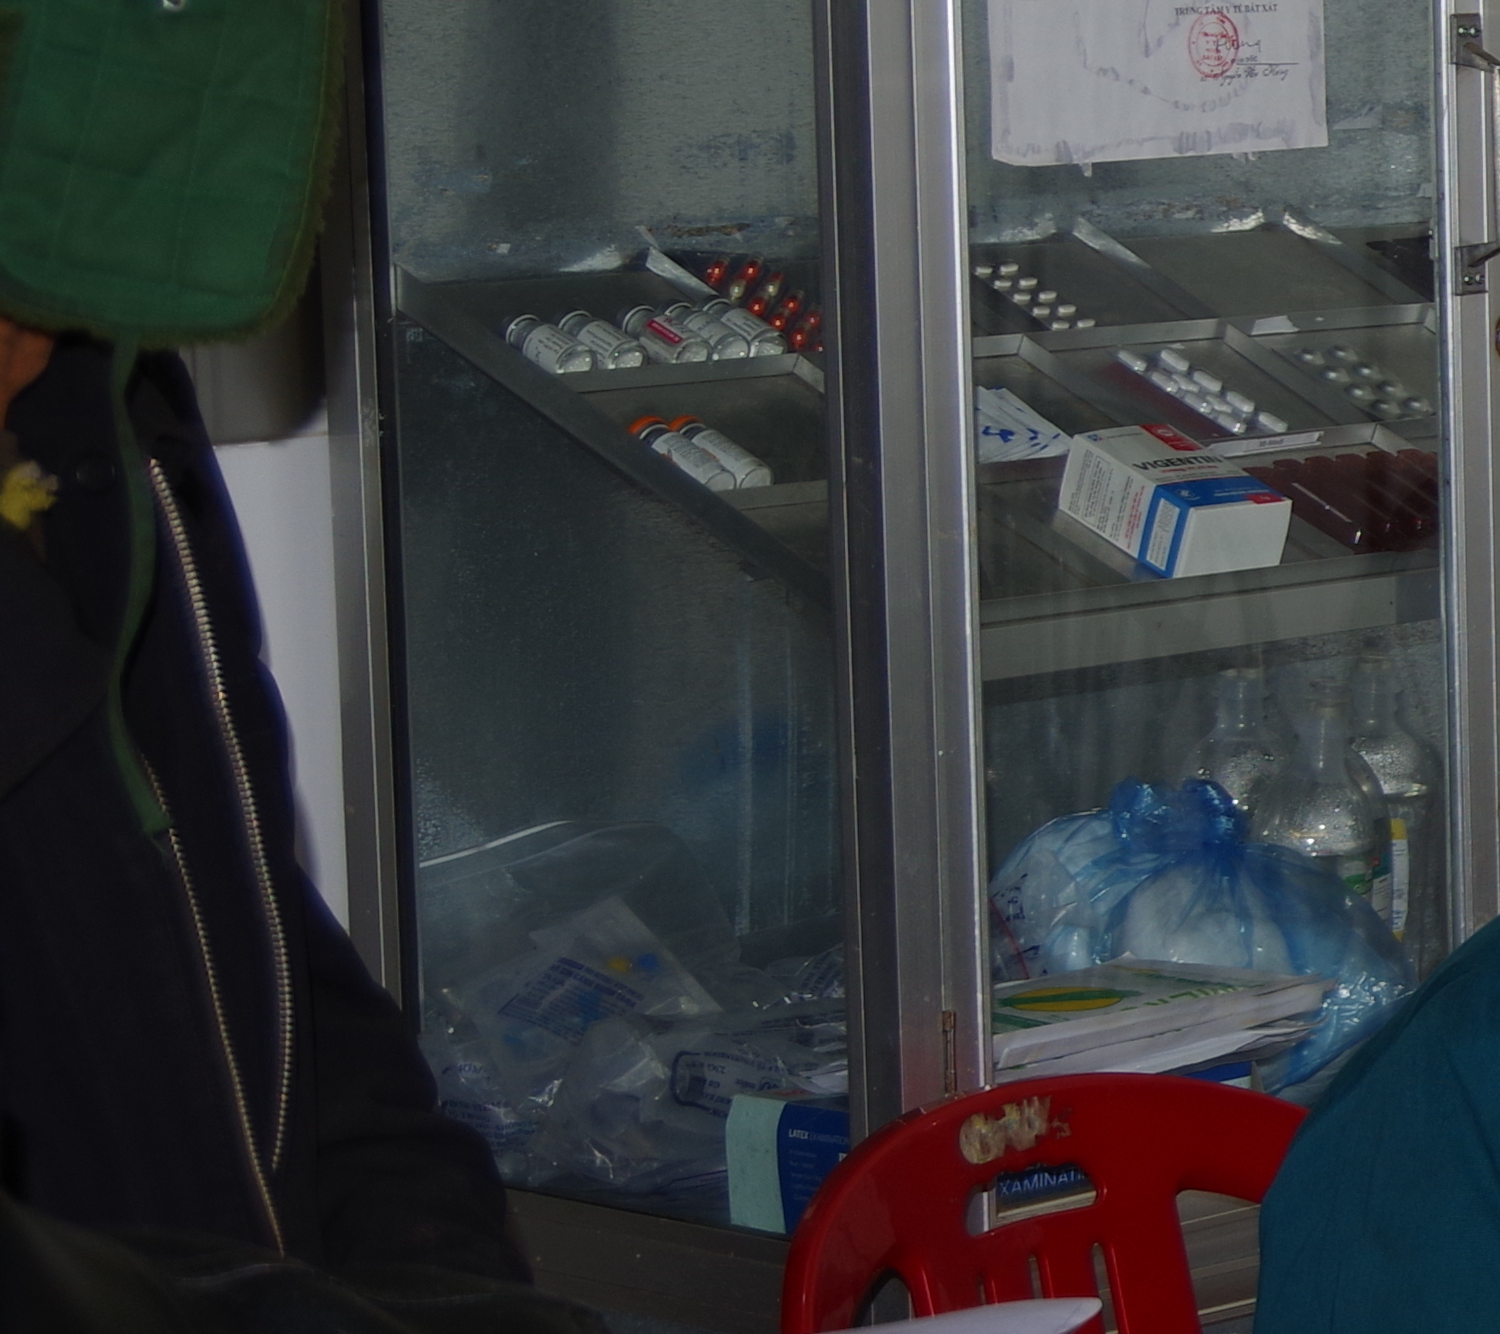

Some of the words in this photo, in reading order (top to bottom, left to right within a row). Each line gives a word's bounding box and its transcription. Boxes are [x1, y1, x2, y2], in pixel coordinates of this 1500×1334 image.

[1175, 7, 1203, 16] TRUNG
[1133, 455, 1223, 470] VIGENTIN
[788, 1128, 809, 1140] LATEX
